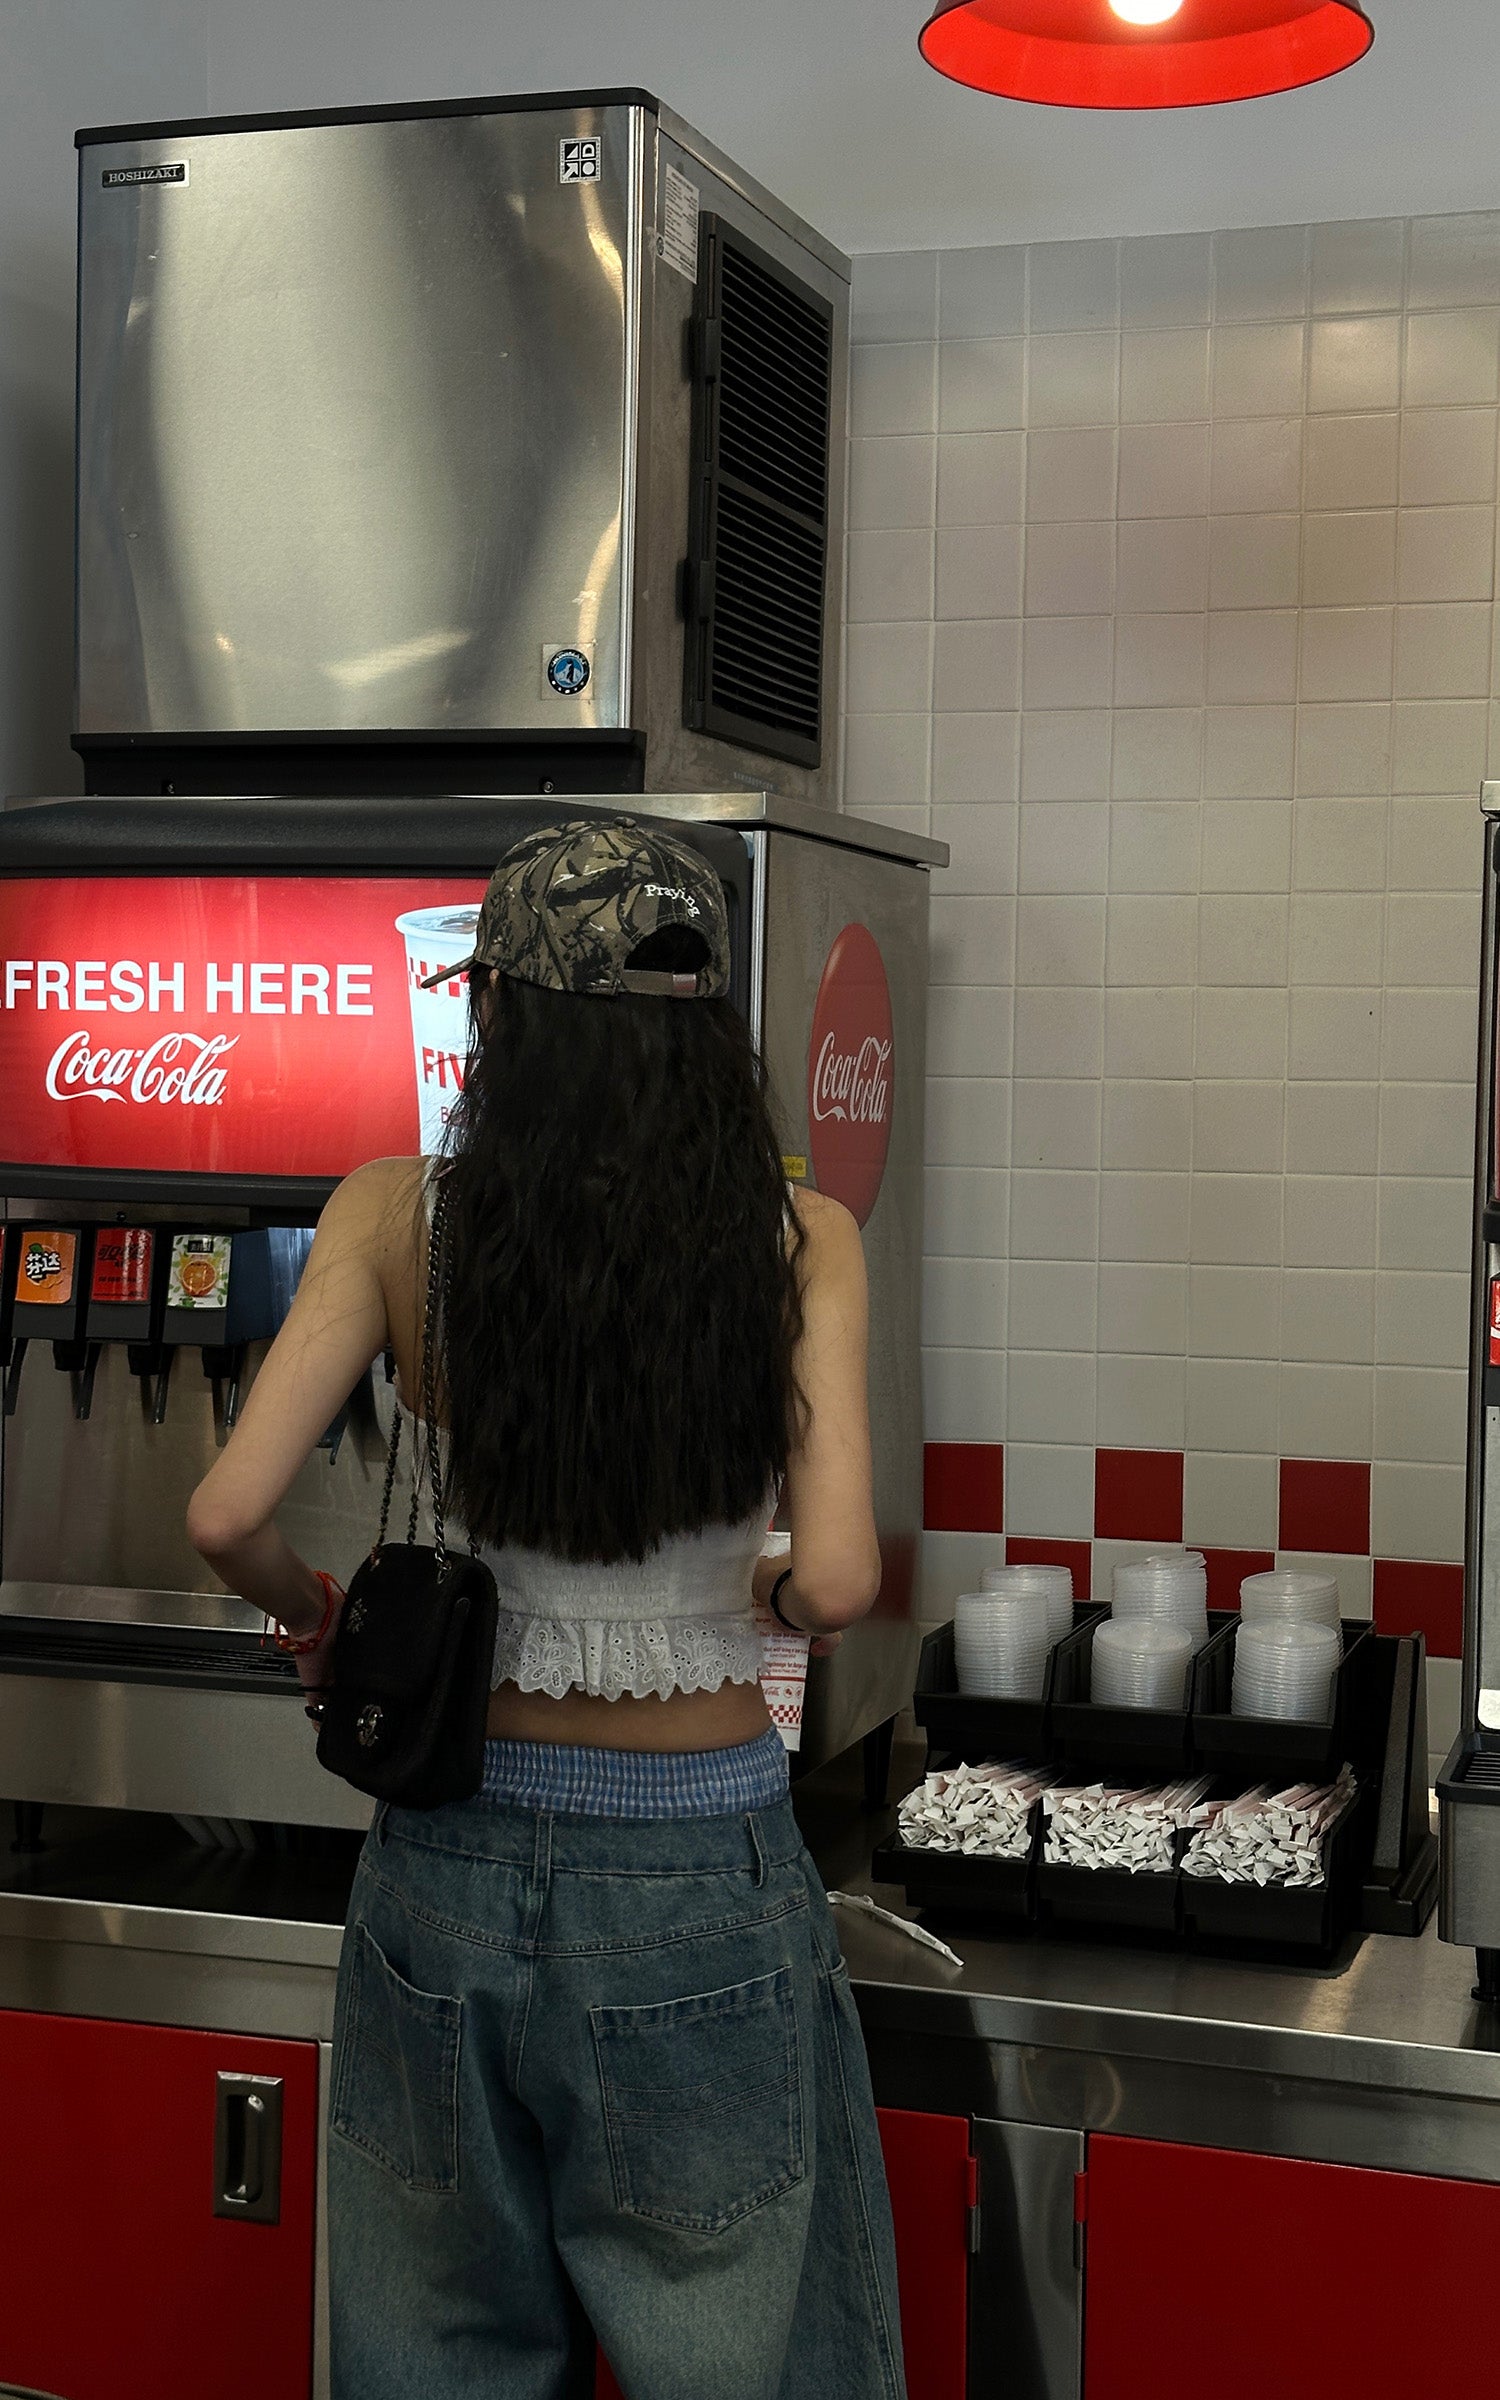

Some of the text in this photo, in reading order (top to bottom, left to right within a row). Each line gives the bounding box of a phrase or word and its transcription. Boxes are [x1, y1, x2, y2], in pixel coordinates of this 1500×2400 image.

[108, 169, 177, 183] HOSHIZAKI
[644, 884, 700, 918] Praying
[0, 960, 374, 1016] FRESH HERE
[46, 1030, 240, 1105] Coca-Cola
[422, 1046, 466, 1092] FIV
[813, 1031, 892, 1123] Coca-Cola
